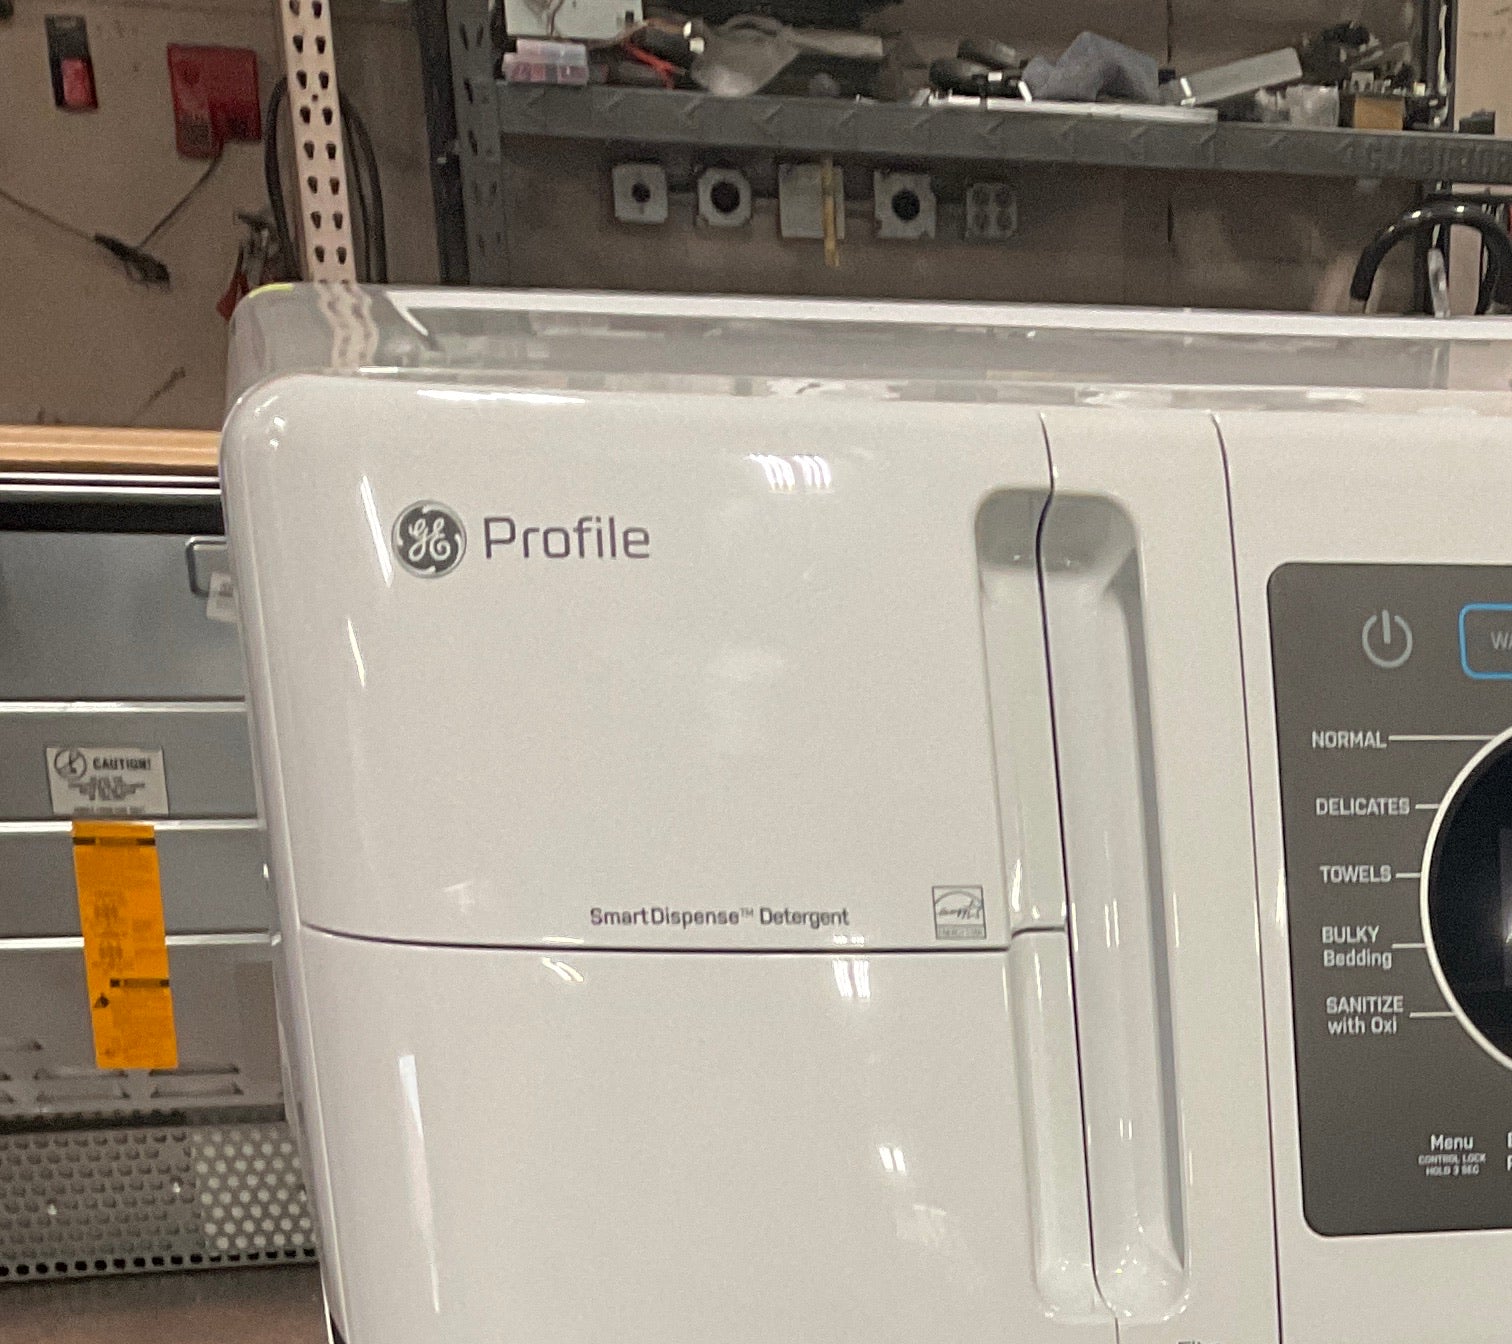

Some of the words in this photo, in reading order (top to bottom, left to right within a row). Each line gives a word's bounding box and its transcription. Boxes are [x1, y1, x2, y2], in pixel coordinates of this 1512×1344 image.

[483, 515, 651, 560] Profile
[1311, 730, 1388, 749] NORMAL
[1315, 797, 1411, 816] DELICATES
[1319, 864, 1392, 884] TOWELS
[758, 906, 850, 930] Detergent
[1321, 925, 1380, 944] BULKY
[1323, 947, 1393, 971] Bedding
[1326, 995, 1404, 1014] SANITIZE
[1327, 1015, 1366, 1035] with
[1430, 1133, 1475, 1151] Menu
